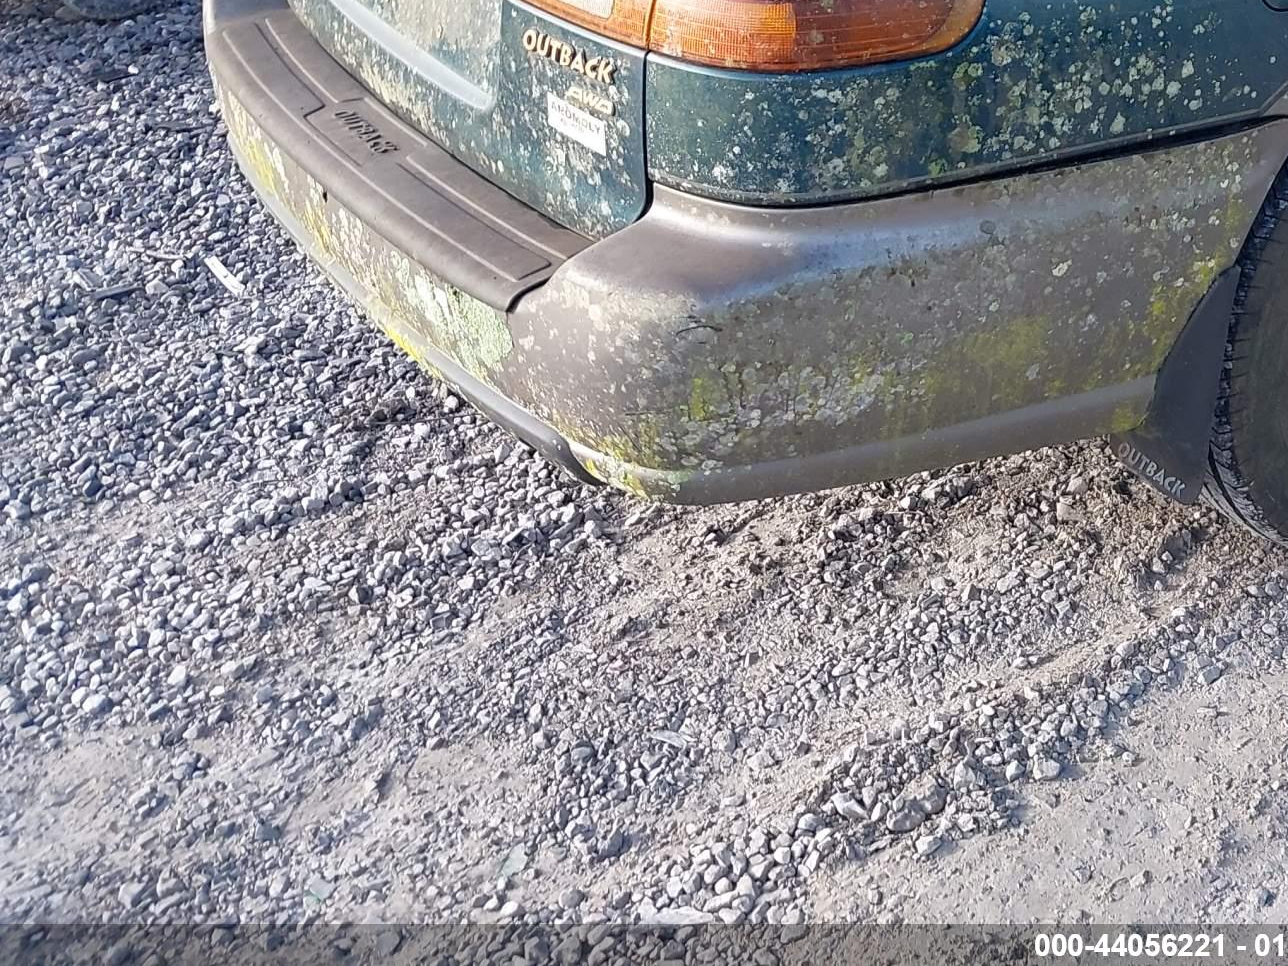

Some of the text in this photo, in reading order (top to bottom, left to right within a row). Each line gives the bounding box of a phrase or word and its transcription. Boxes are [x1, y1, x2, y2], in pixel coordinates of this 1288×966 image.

[522, 28, 614, 85] OUTBACK
[565, 87, 615, 116] AWD
[333, 109, 399, 155] OUTBACK
[1118, 442, 1186, 498] OUTBACK
